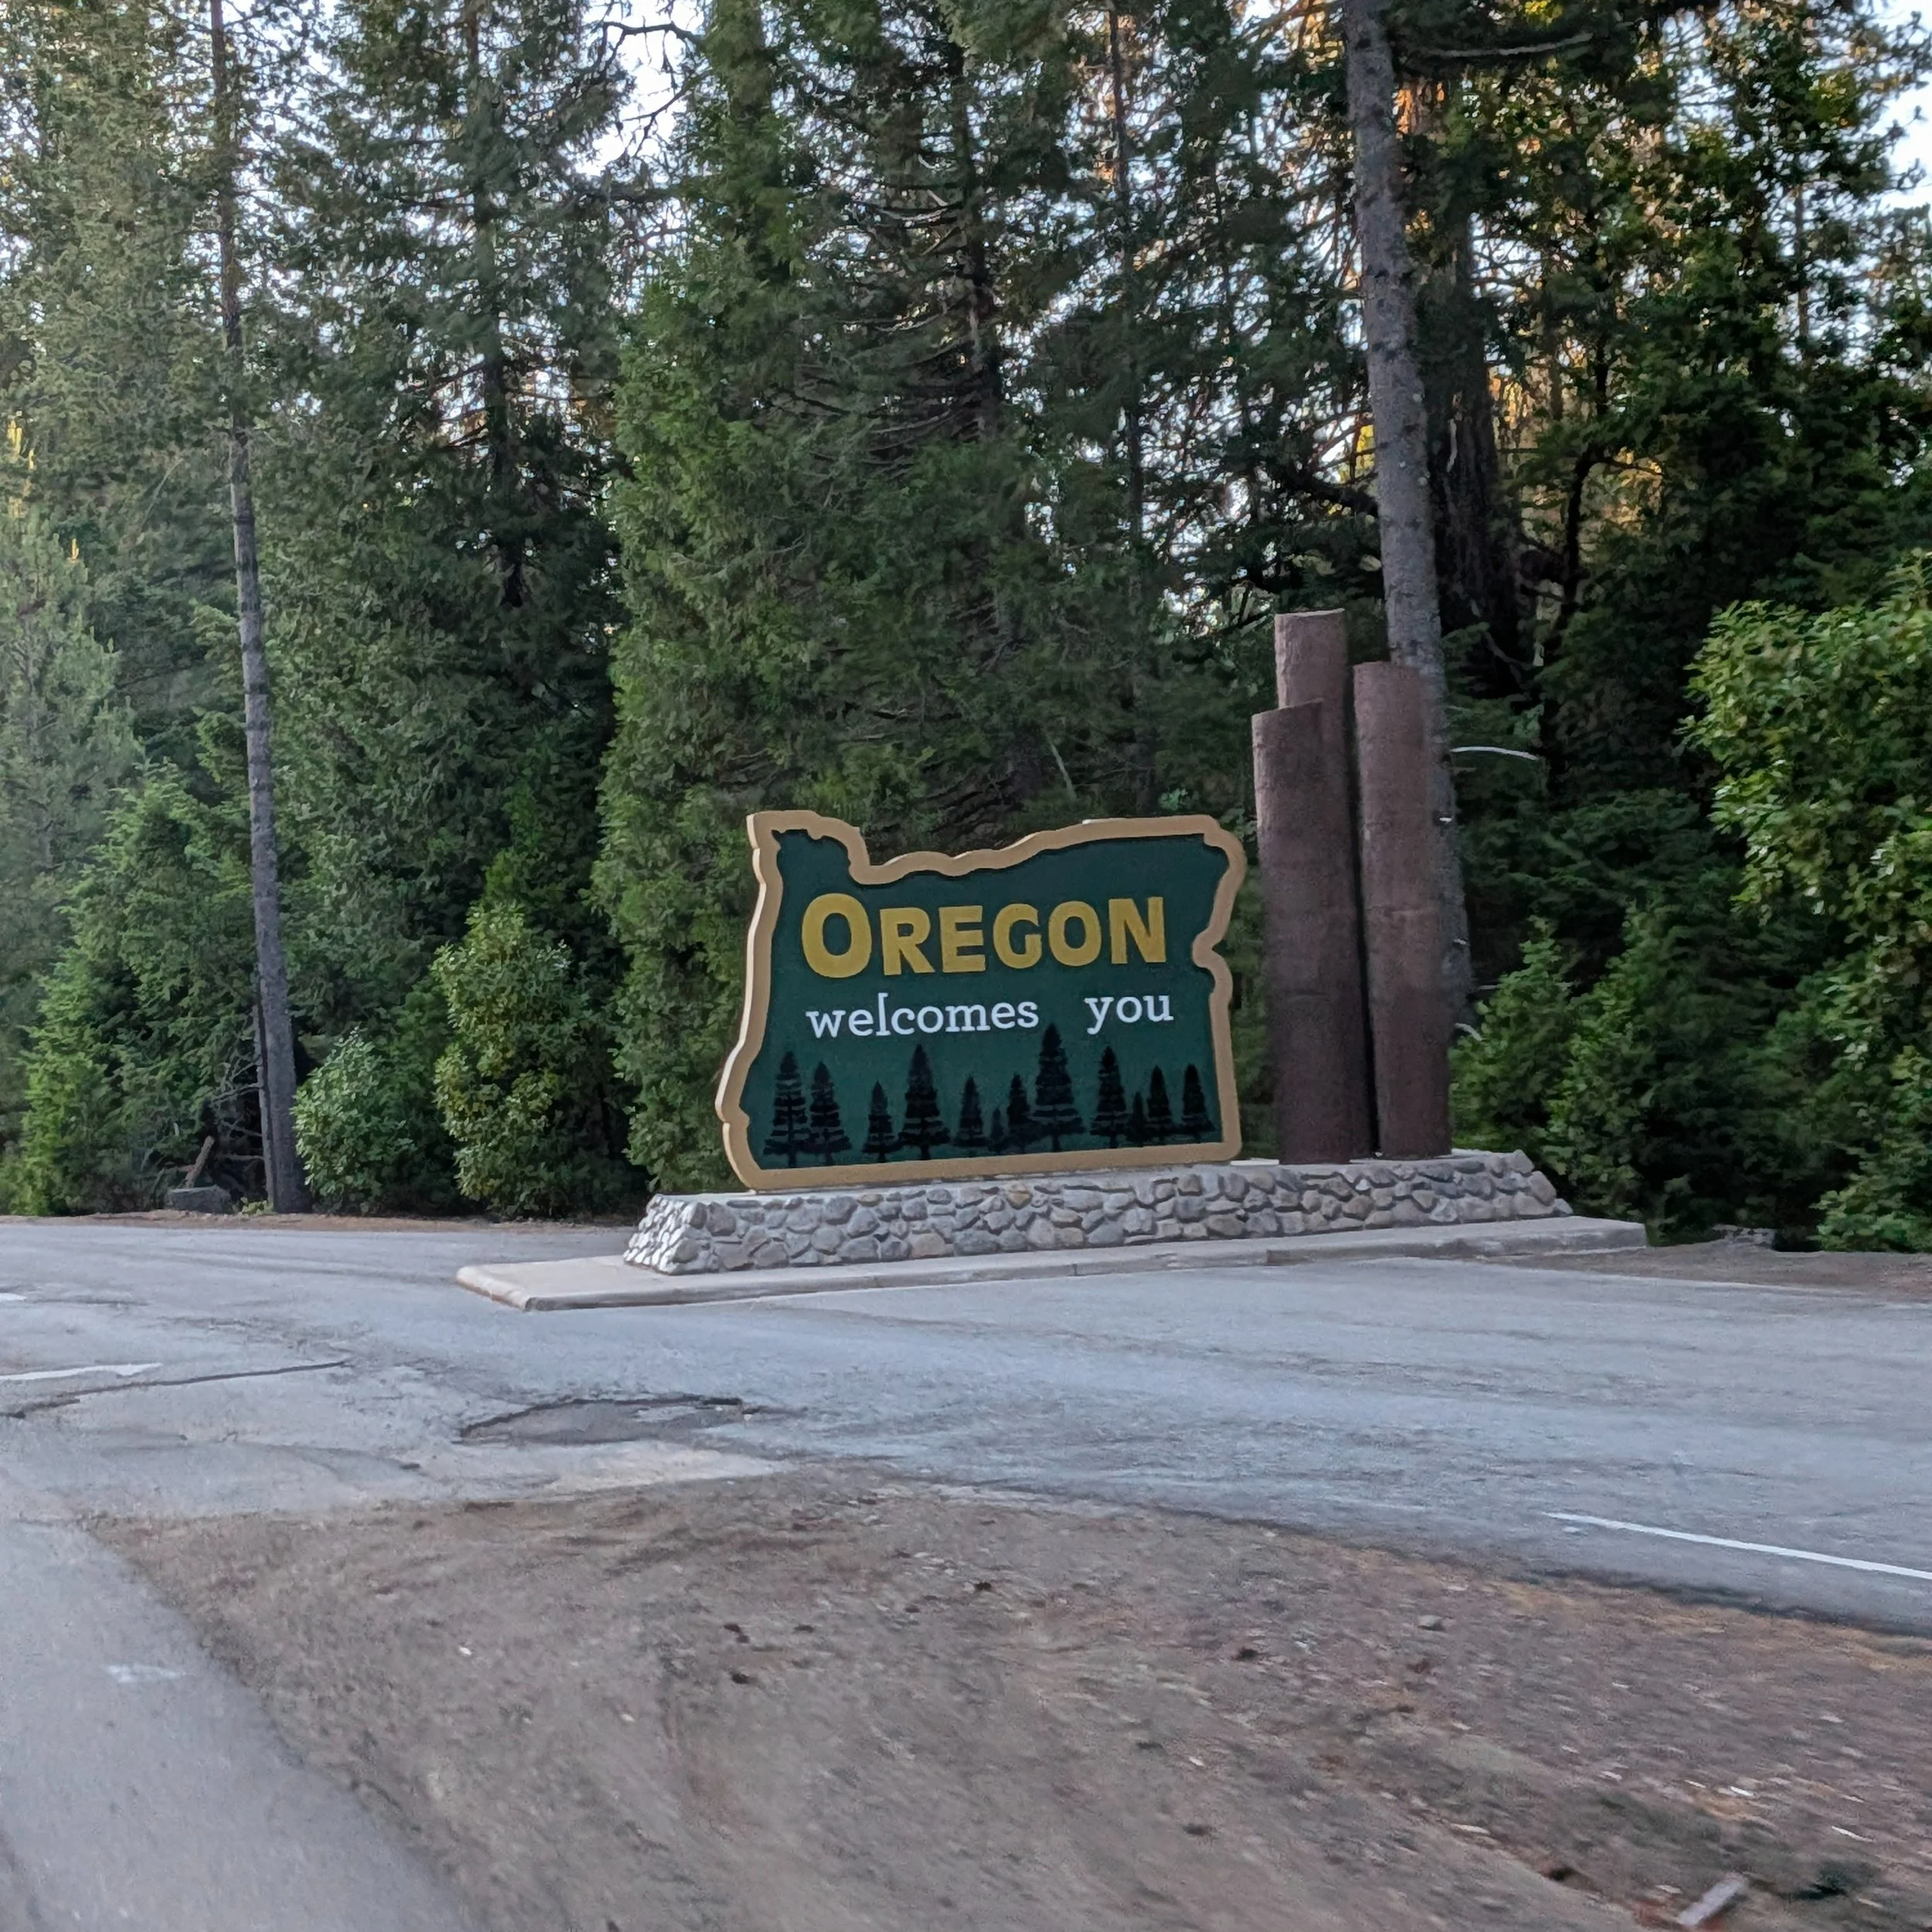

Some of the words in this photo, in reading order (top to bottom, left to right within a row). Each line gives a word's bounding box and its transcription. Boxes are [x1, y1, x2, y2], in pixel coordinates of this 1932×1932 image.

[801, 893, 1167, 978] OREGON
[805, 992, 1039, 1039] welcomes
[1083, 993, 1174, 1035] you
